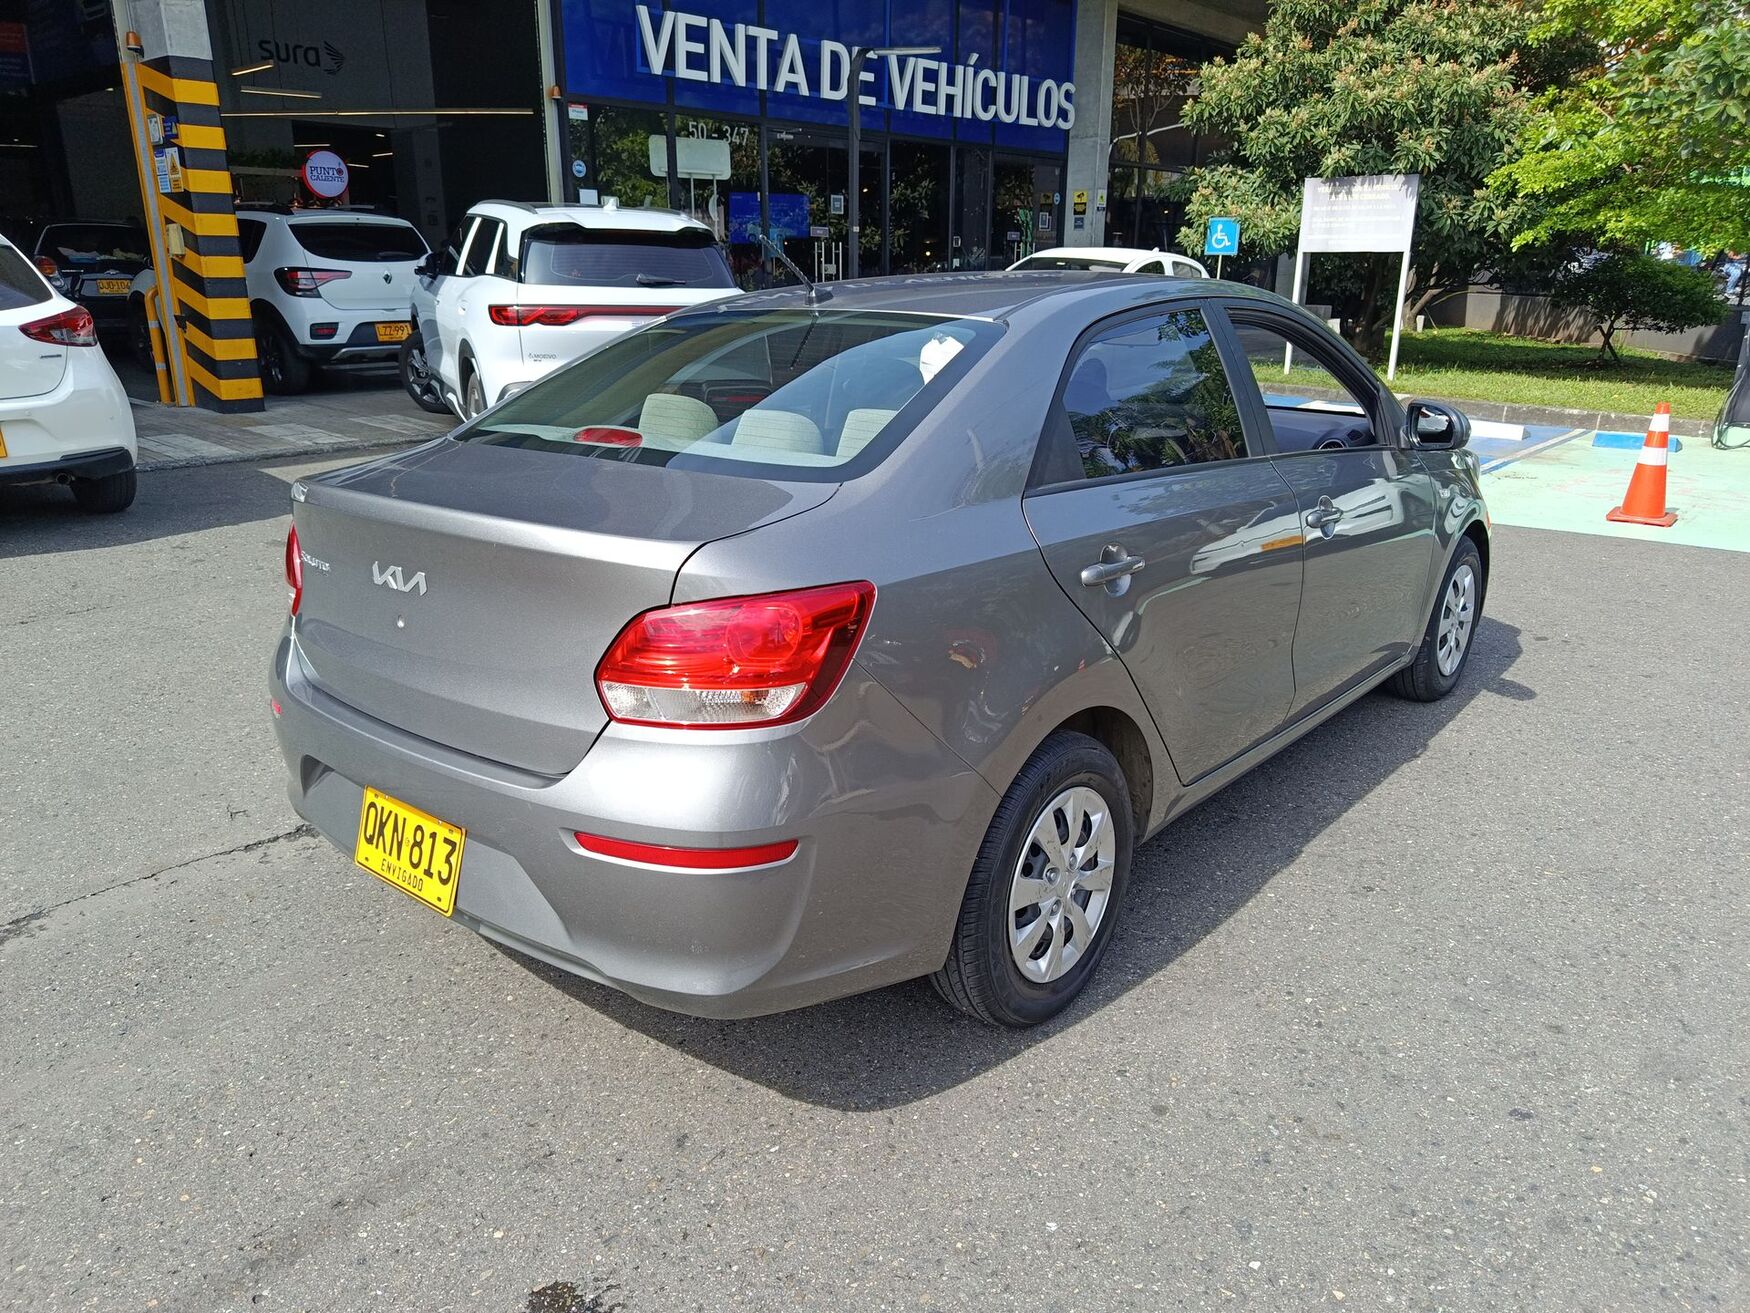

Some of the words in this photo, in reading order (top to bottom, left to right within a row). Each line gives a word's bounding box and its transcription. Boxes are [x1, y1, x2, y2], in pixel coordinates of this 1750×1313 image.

[258, 40, 321, 67] sura
[636, 5, 809, 96] VENTA
[820, 39, 878, 106] DE
[887, 52, 1076, 130] VEHÍCULOS
[688, 121, 707, 140] 50
[722, 125, 749, 146] 347
[310, 166, 344, 176] PUNTO
[310, 175, 344, 183] CALIENTE
[372, 561, 427, 596] KIA
[364, 801, 406, 861] QKN
[409, 824, 457, 886] 813
[380, 858, 424, 892] ENVIGADO
